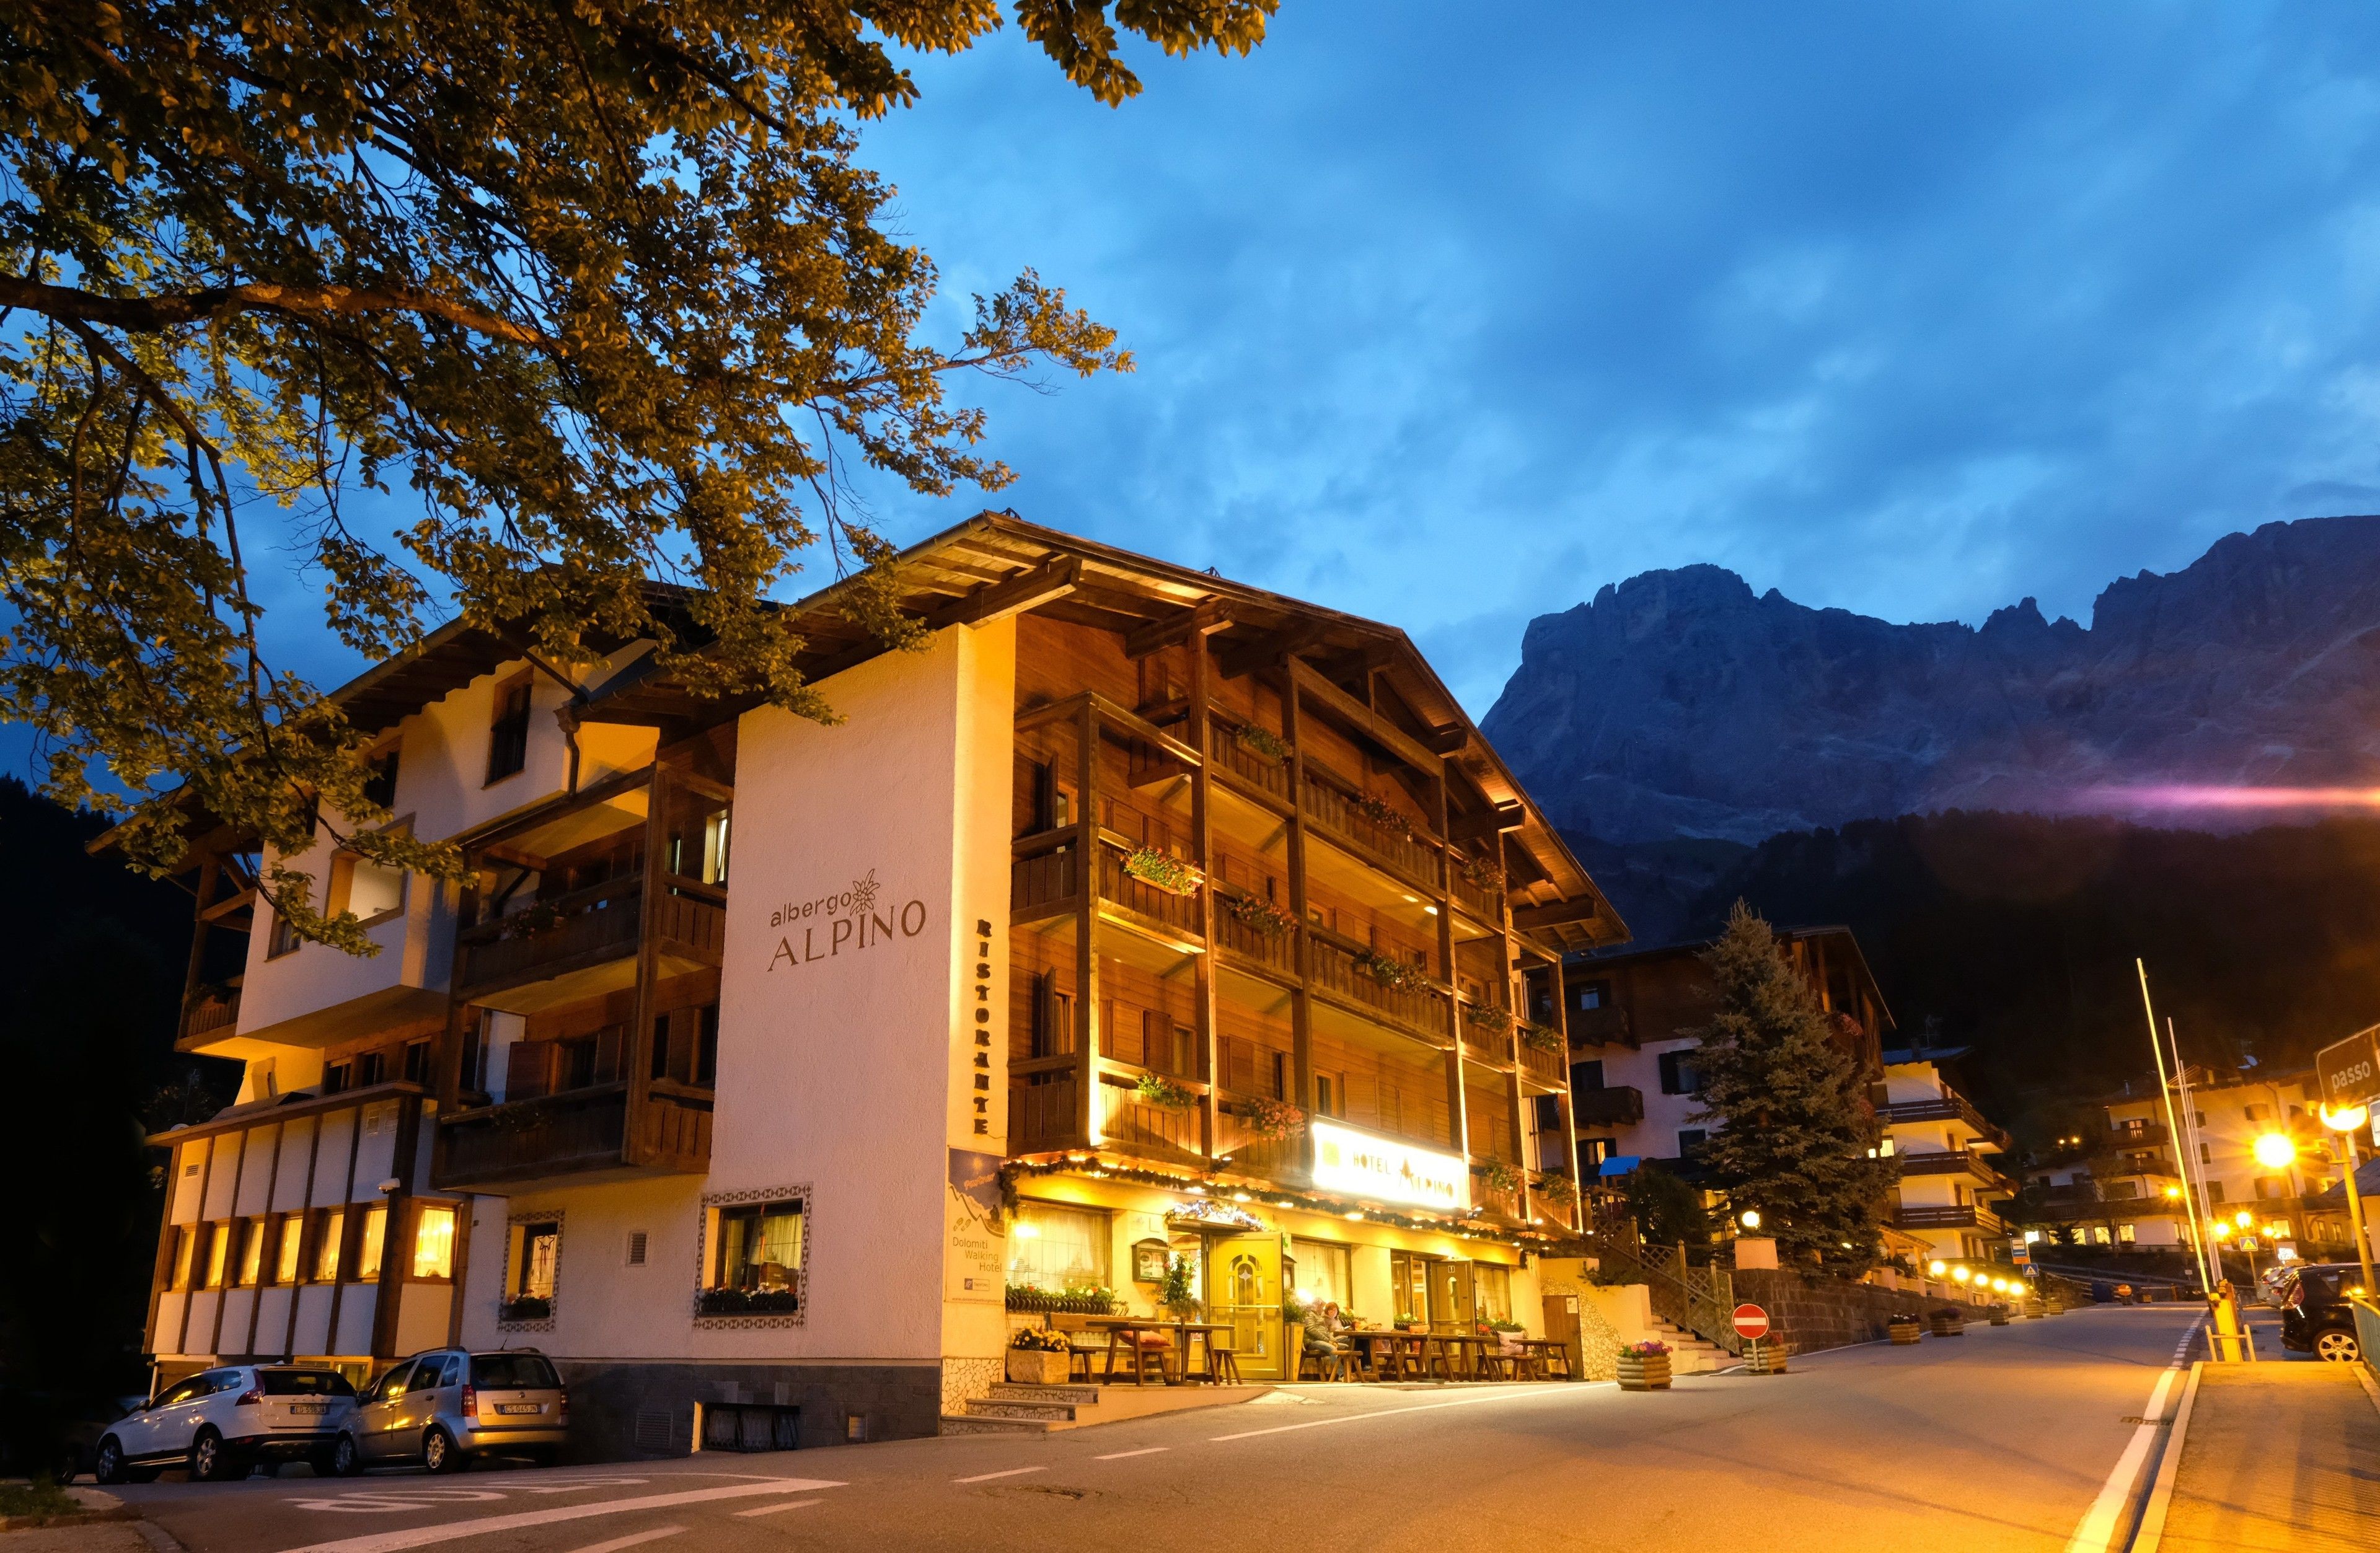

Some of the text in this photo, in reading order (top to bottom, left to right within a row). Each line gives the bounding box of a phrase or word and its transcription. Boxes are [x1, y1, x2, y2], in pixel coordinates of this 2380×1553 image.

[770, 891, 852, 928] albergo
[767, 900, 927, 972] ALPINO
[973, 919, 992, 1135] RISTORANTE
[2331, 1061, 2371, 1094] passo
[1354, 1151, 1391, 1175] HOTEL
[953, 1236, 988, 1249] Dolomiti
[965, 1249, 998, 1263] Walking
[979, 1262, 1002, 1272] Hotel
